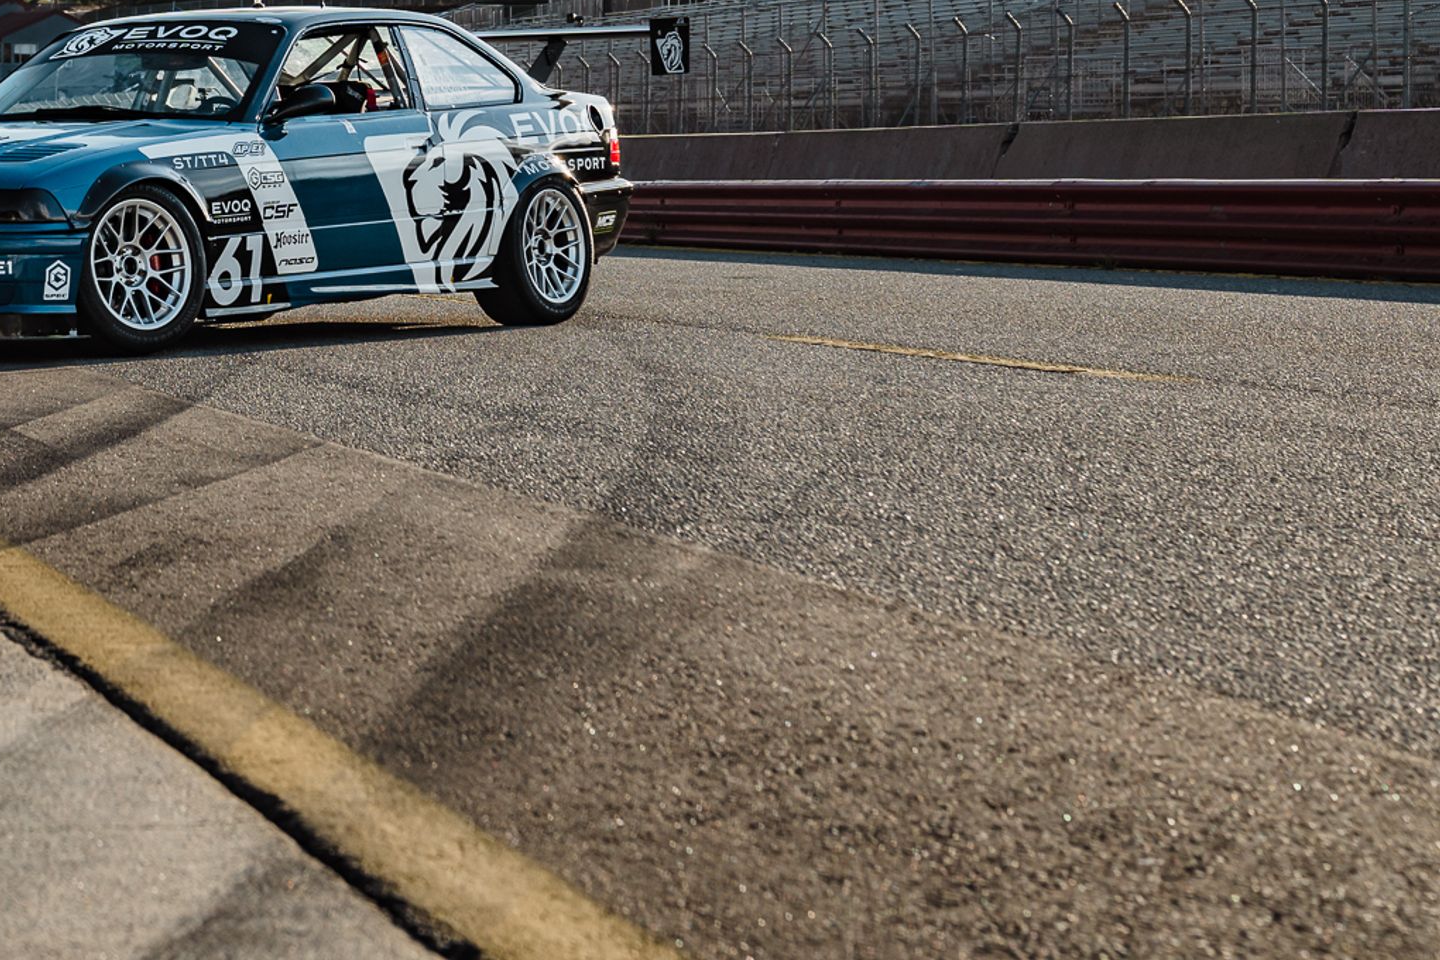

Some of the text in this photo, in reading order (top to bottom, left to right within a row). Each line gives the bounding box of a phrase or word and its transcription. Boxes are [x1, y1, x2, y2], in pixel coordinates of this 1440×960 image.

[123, 25, 238, 41] EVOQ
[112, 42, 227, 51] MOTORSPORT
[509, 109, 594, 146] EVO
[173, 154, 228, 169] ST/TT4
[524, 156, 606, 175] MOSPORT
[212, 199, 251, 214] EVOQ
[263, 203, 298, 220] CSF
[208, 234, 263, 306] 61
